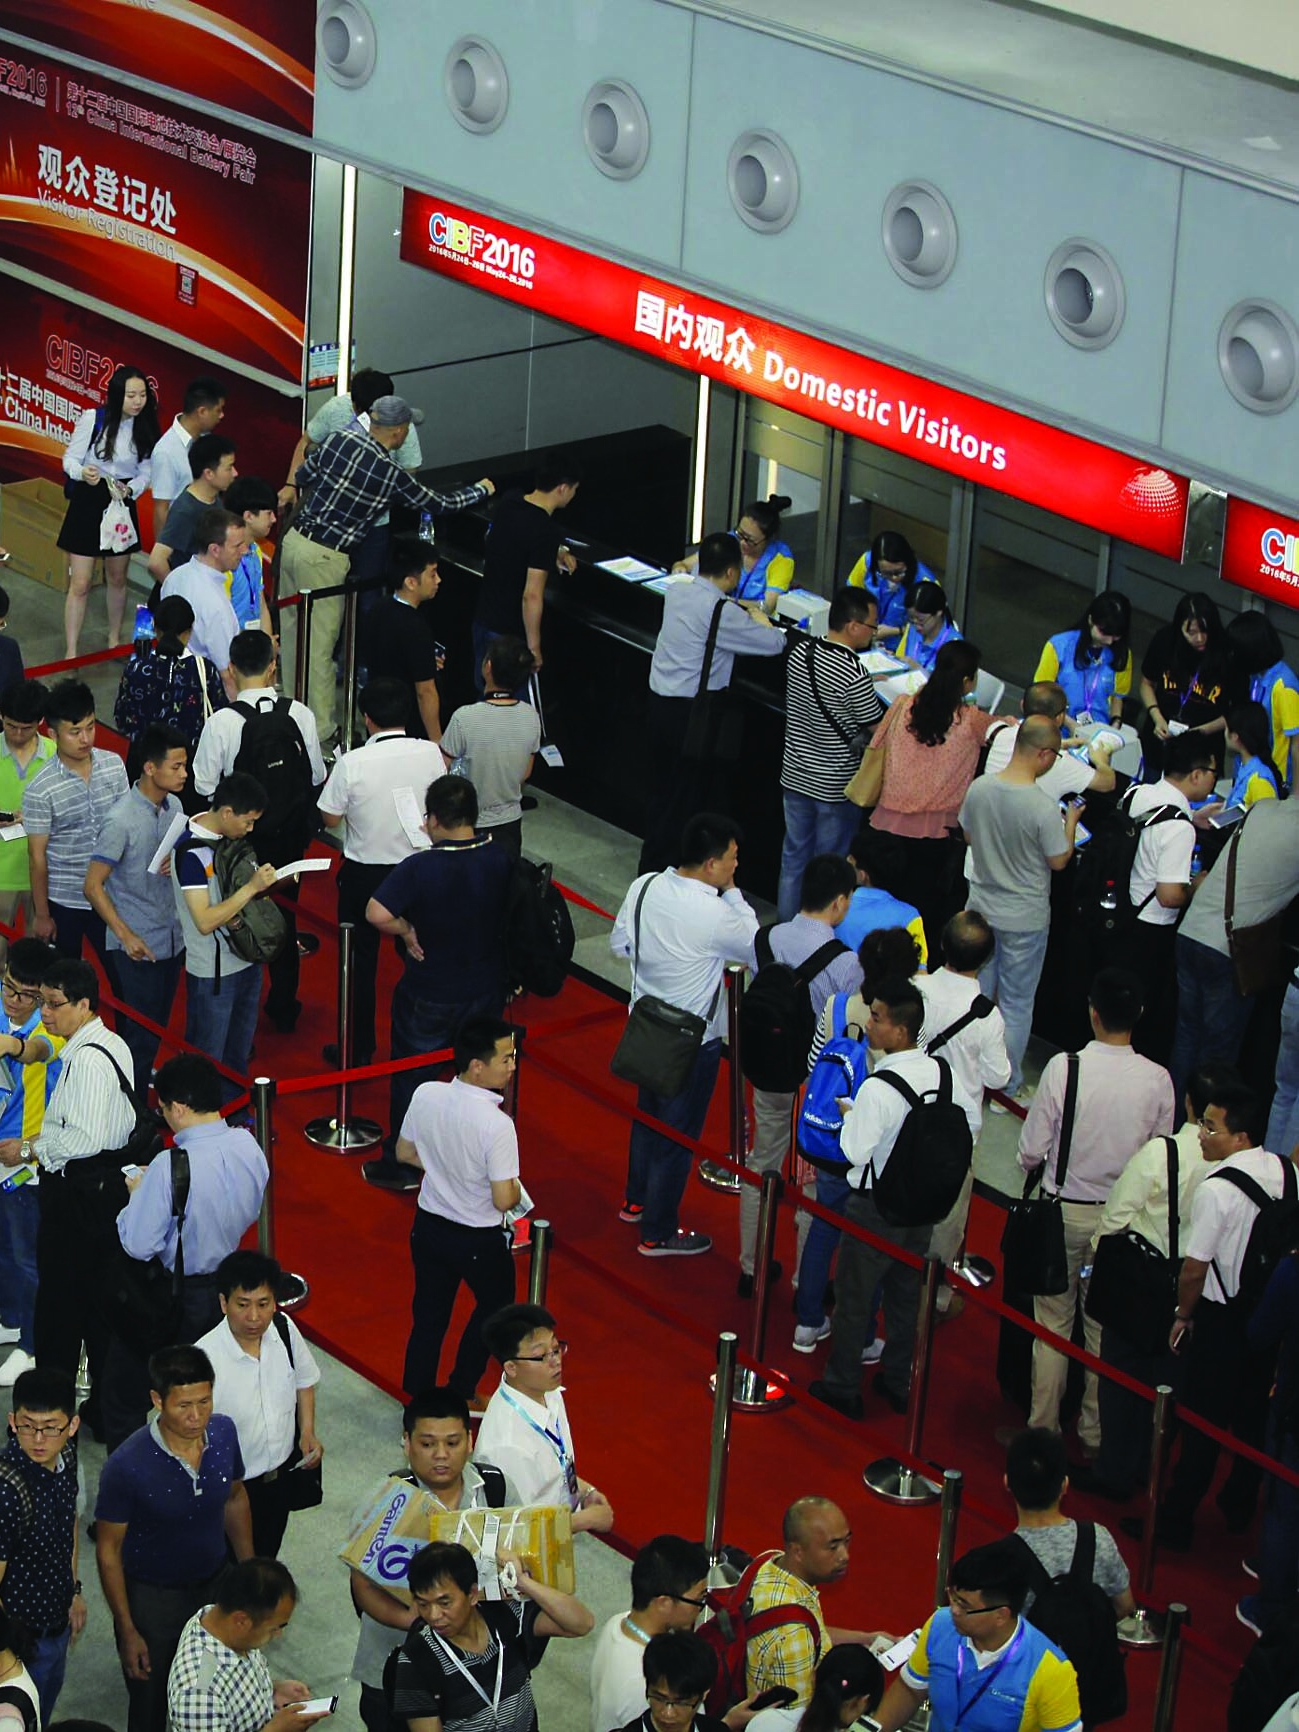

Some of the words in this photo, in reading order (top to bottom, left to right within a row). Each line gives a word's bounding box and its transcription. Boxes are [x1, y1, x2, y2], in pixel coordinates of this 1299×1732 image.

[86, 108, 117, 134] China
[119, 119, 188, 161] International
[189, 148, 231, 179] Battery
[232, 168, 257, 185] Fair
[37, 143, 177, 236] 观众登记处
[37, 187, 85, 222] Visitor
[87, 206, 176, 261] Registration
[428, 212, 536, 279] CIBF2016
[634, 290, 757, 375] 国内观众
[762, 350, 892, 427] Domestic
[898, 400, 1007, 471] Visitors
[44, 415, 72, 446] Inte
[1260, 563, 1299, 589] 2016年5月
[1261, 527, 1299, 577] CI
